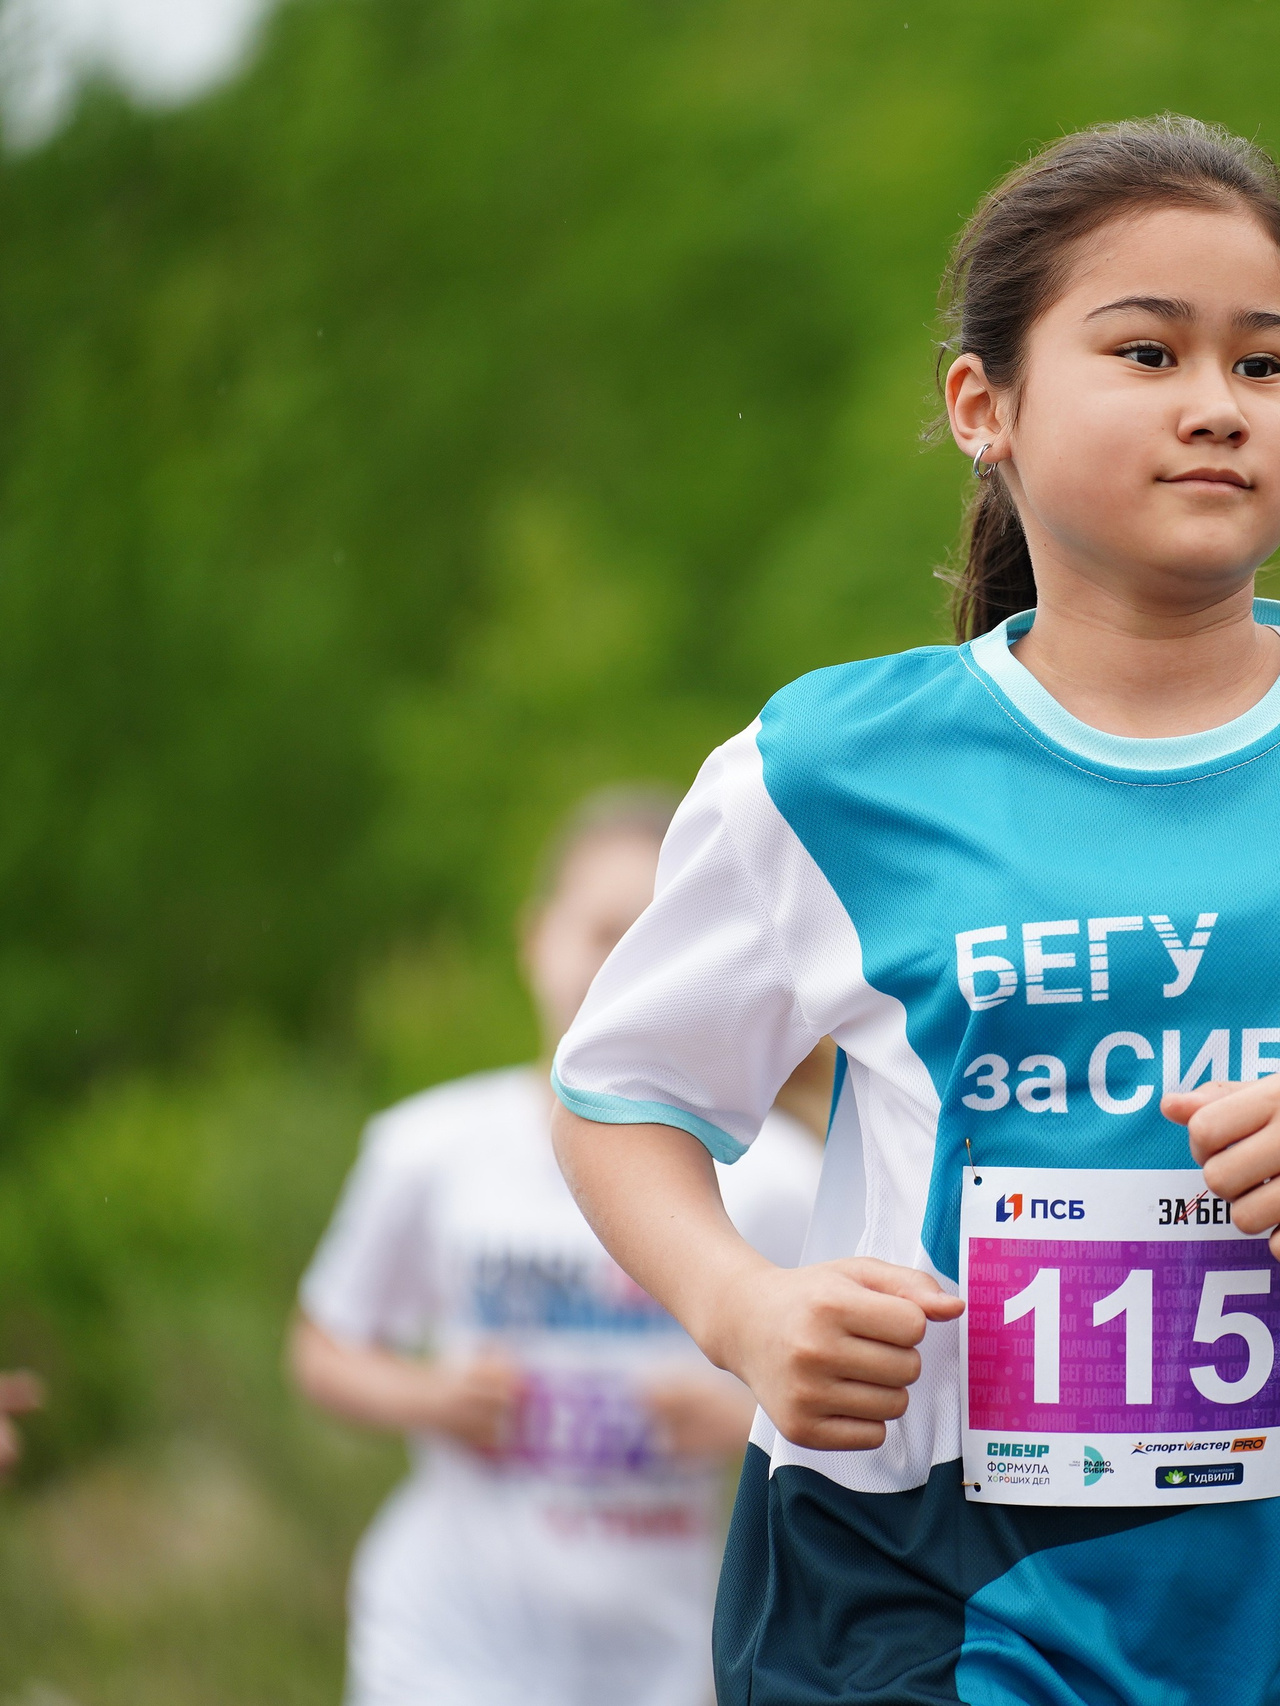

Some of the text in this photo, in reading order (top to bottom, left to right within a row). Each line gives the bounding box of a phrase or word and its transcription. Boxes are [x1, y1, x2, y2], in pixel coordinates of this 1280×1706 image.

[955, 912, 1218, 1011] БЕГУ
[961, 1053, 1068, 1114] за
[1030, 1198, 1086, 1220] ПСБ
[987, 1442, 1050, 1458] СИБУР
[1232, 1439, 1264, 1450] PRO
[987, 1461, 1050, 1474] ФОРМУЛА
[987, 1474, 1050, 1486] ХОРОШИХ ДЕЛ
